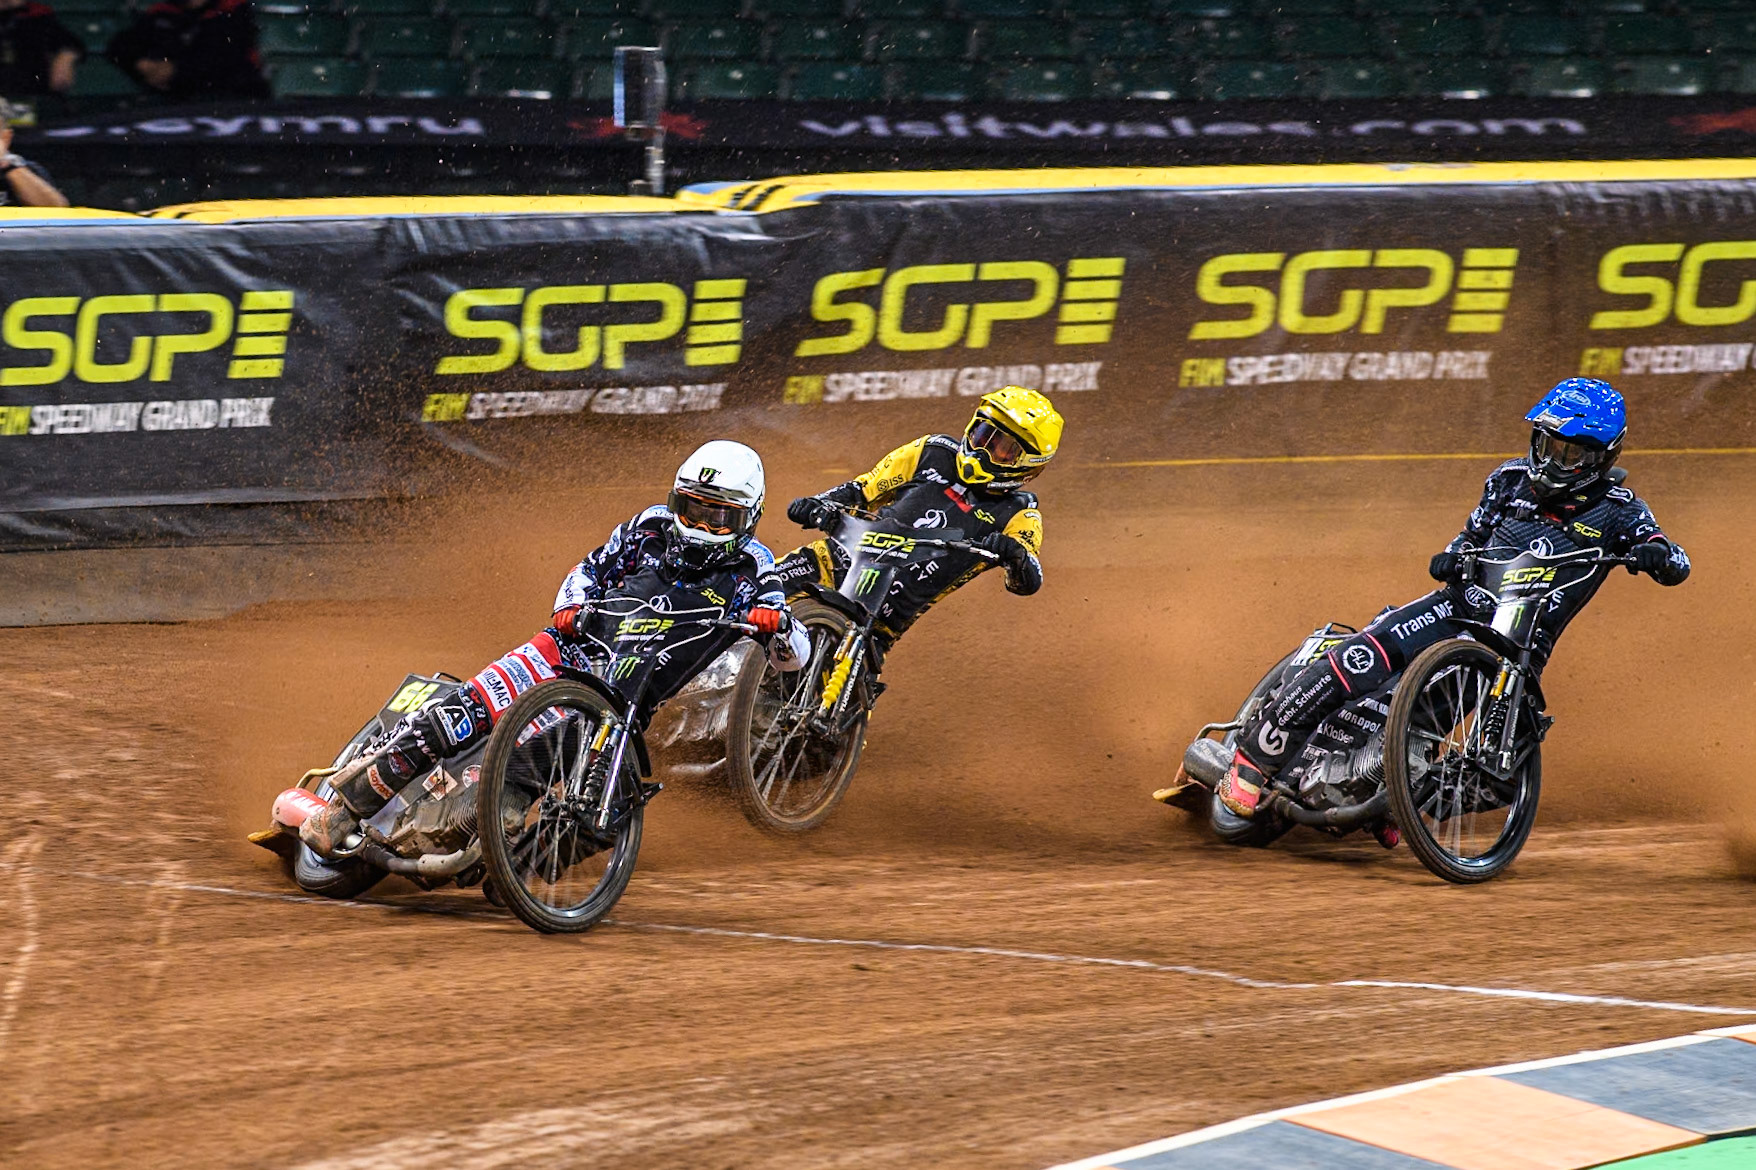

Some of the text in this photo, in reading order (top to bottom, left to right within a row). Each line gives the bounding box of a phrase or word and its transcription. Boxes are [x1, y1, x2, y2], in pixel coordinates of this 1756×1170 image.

[1226, 352, 1352, 386] SPEEDWAY
[1349, 351, 1434, 381] GRAND
[1431, 350, 1494, 380] PRIX
[1621, 342, 1753, 375] SPEEDWAY
[822, 368, 958, 404] SPEEDWAY
[955, 364, 1043, 397] GRAND
[1041, 361, 1103, 392] PRIX
[29, 402, 145, 435] SPEEDWAY
[141, 399, 219, 432] GRAND
[217, 397, 275, 429] PRIX
[466, 388, 598, 420] SPEEDWAY
[591, 385, 678, 415] GRAND
[677, 382, 729, 413] PRIX
[1573, 522, 1602, 538] SGP
[1390, 610, 1436, 640] Trans
[1294, 674, 1333, 709] Schwarte
